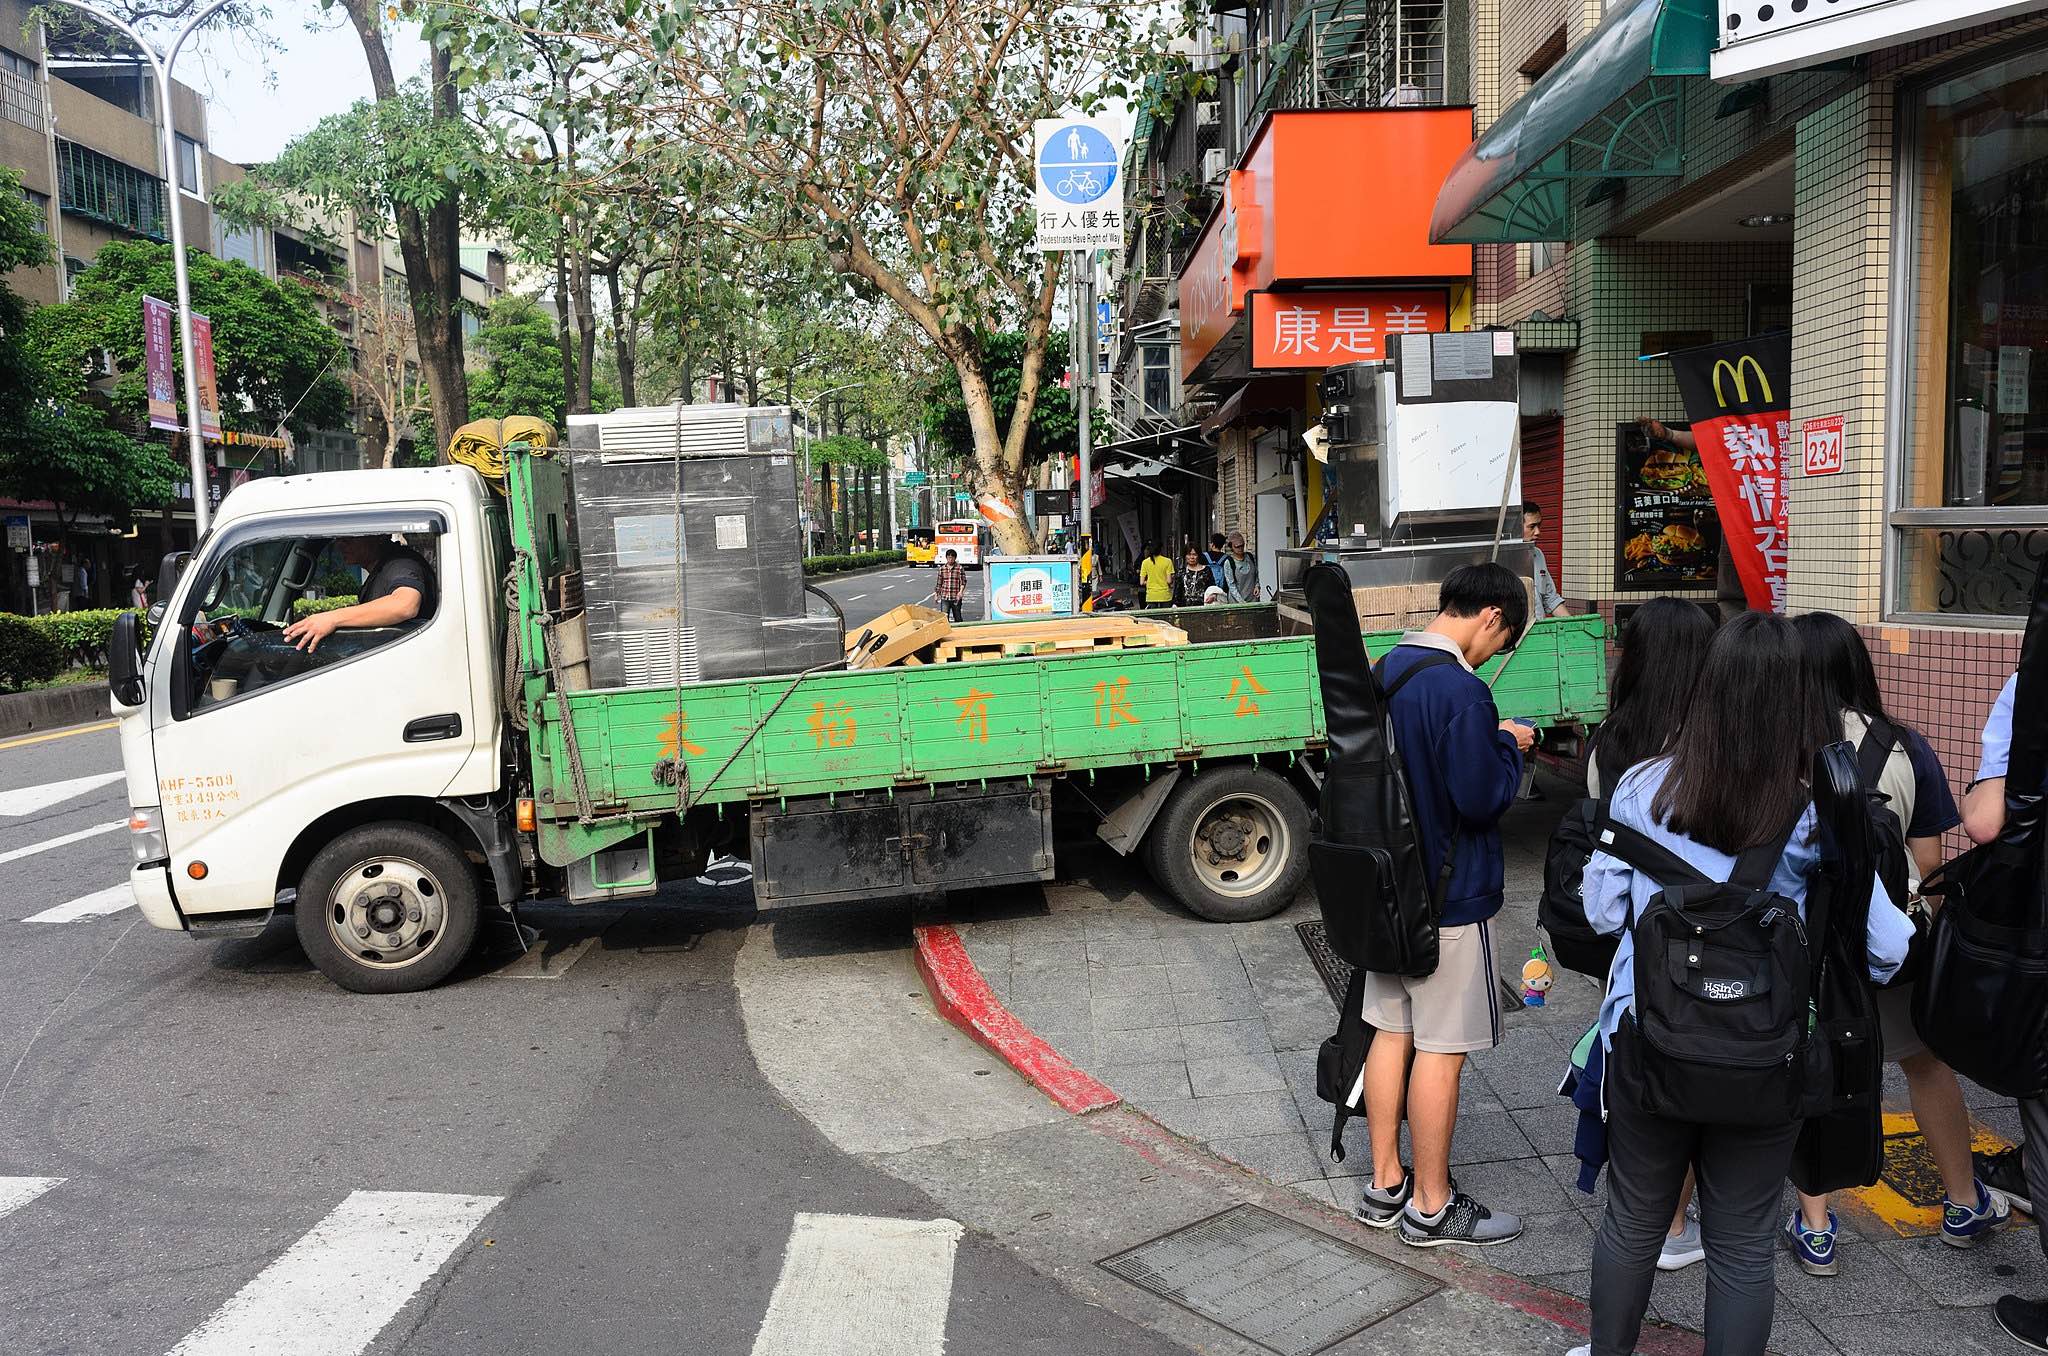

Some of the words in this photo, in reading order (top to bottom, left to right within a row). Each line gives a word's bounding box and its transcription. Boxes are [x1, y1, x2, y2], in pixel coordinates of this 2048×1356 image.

[1040, 210, 1120, 229] 行人優先
[1040, 234, 1072, 244] Pedestrians
[1073, 234, 1086, 244] Have
[1087, 233, 1101, 245] Right
[1102, 233, 1108, 243] of
[1109, 233, 1121, 245] Way
[1809, 439, 1838, 467] 234
[1020, 580, 1043, 592] 開車
[1010, 593, 1043, 607] 不超速
[1709, 991, 1744, 999] Chuan
